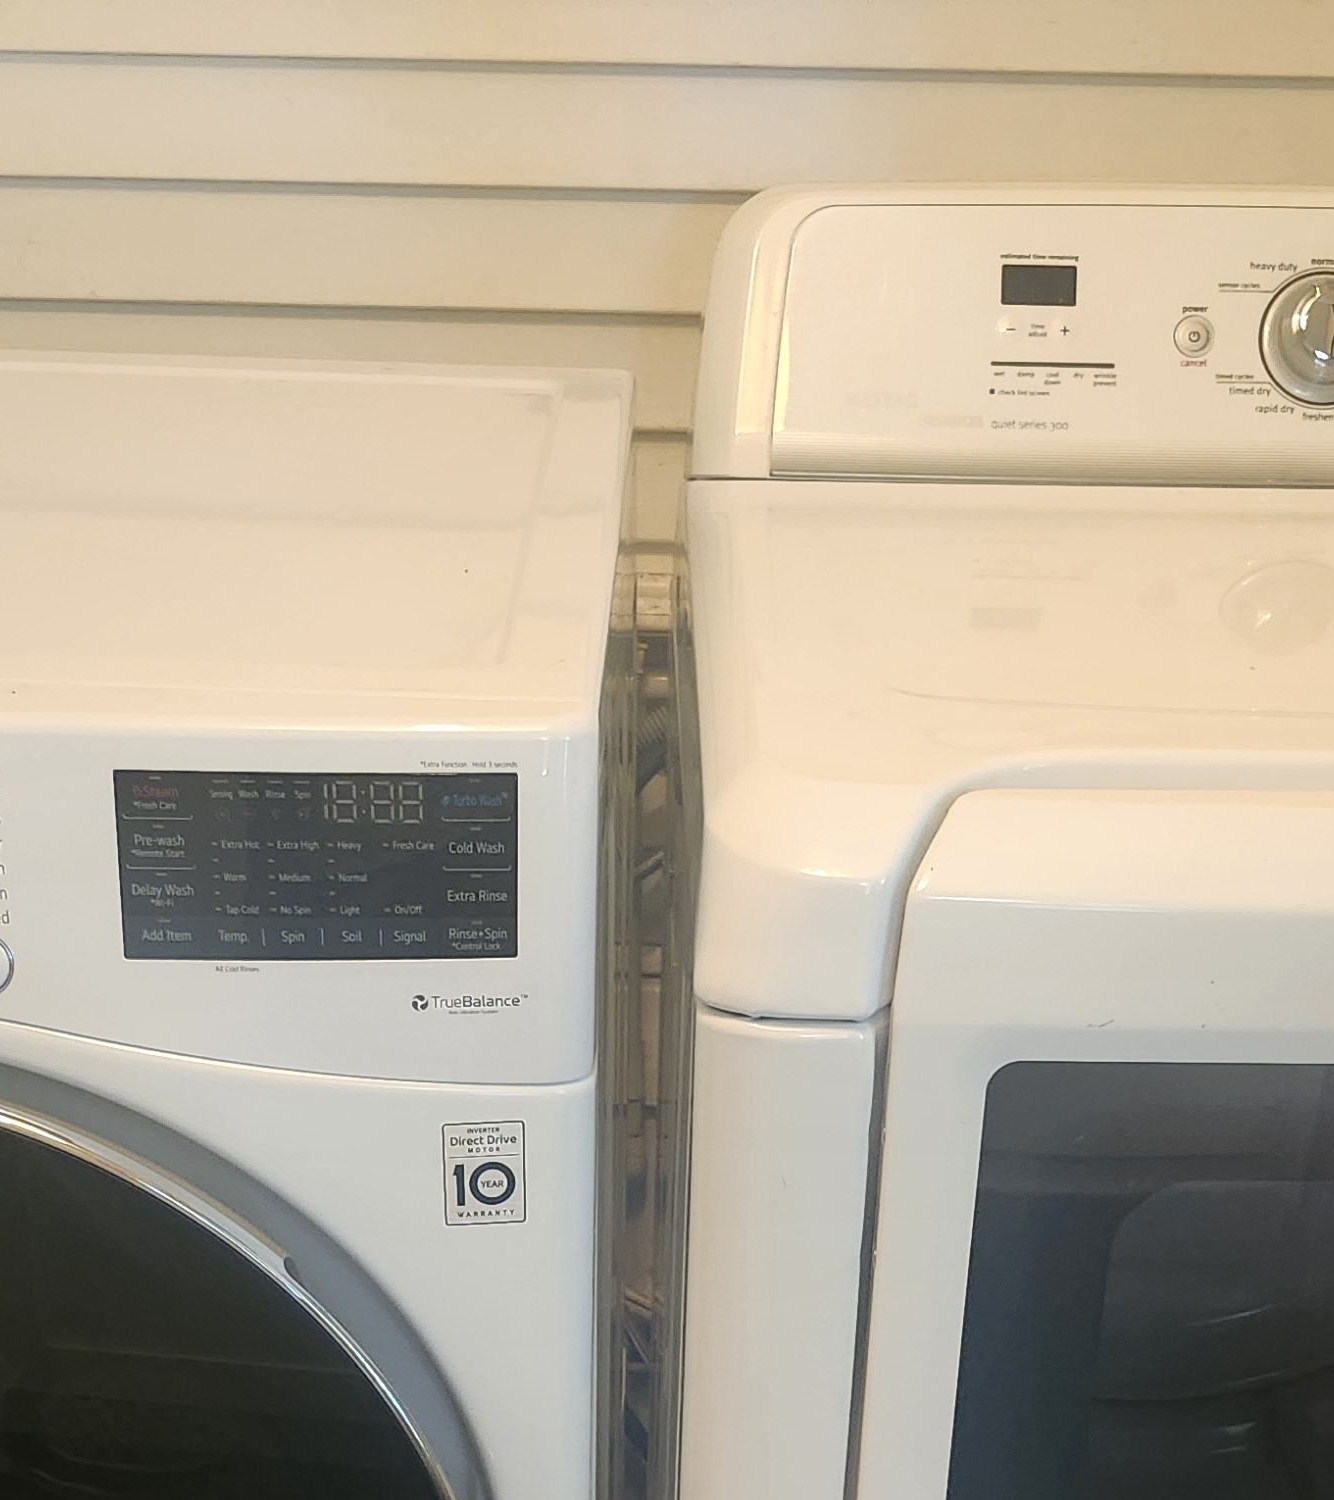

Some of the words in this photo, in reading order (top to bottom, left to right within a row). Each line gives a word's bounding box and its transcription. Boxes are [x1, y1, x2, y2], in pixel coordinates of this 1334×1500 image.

[1182, 306, 1208, 314] power
[1180, 359, 1207, 367] cancel
[1229, 386, 1254, 395] timed
[1257, 386, 1271, 396] dry
[1255, 405, 1278, 414] rapid
[1280, 404, 1295, 414] dry
[1302, 413, 1334, 421] freshen
[134, 834, 185, 847] Pre-wash
[221, 840, 244, 849] Extra
[246, 841, 260, 849] Hot
[277, 840, 299, 849] Extra
[301, 841, 320, 850] High
[392, 841, 415, 850] Fresh
[417, 841, 435, 850] Care
[337, 841, 362, 851] Heavy
[449, 842, 472, 853] Cold
[476, 842, 505, 854] Wash
[224, 873, 246, 881] Warm
[279, 873, 310, 882] Medium
[338, 873, 367, 882] Normal
[132, 884, 161, 897] Delay
[166, 884, 195, 896] Wash
[447, 890, 476, 901] Extra
[479, 890, 508, 901] Rinse
[226, 905, 239, 915] Tap
[241, 905, 259, 913] Cold
[281, 906, 292, 914] No
[294, 906, 312, 916] Spin
[340, 905, 360, 915] Light
[394, 905, 423, 914] On/Off
[142, 930, 163, 941] Add
[167, 930, 192, 941] Item
[219, 930, 250, 944] Temp.
[281, 931, 305, 944] Spin
[342, 931, 362, 943] Soil
[394, 931, 427, 945] Signal
[449, 928, 508, 942] Rinse+Spin
[450, 1136, 485, 1147] Direct
[487, 1134, 518, 1145] Drive
[452, 1161, 516, 1206] 10
[480, 1180, 504, 1188] YEAR
[457, 1209, 515, 1218] WARRANTY
